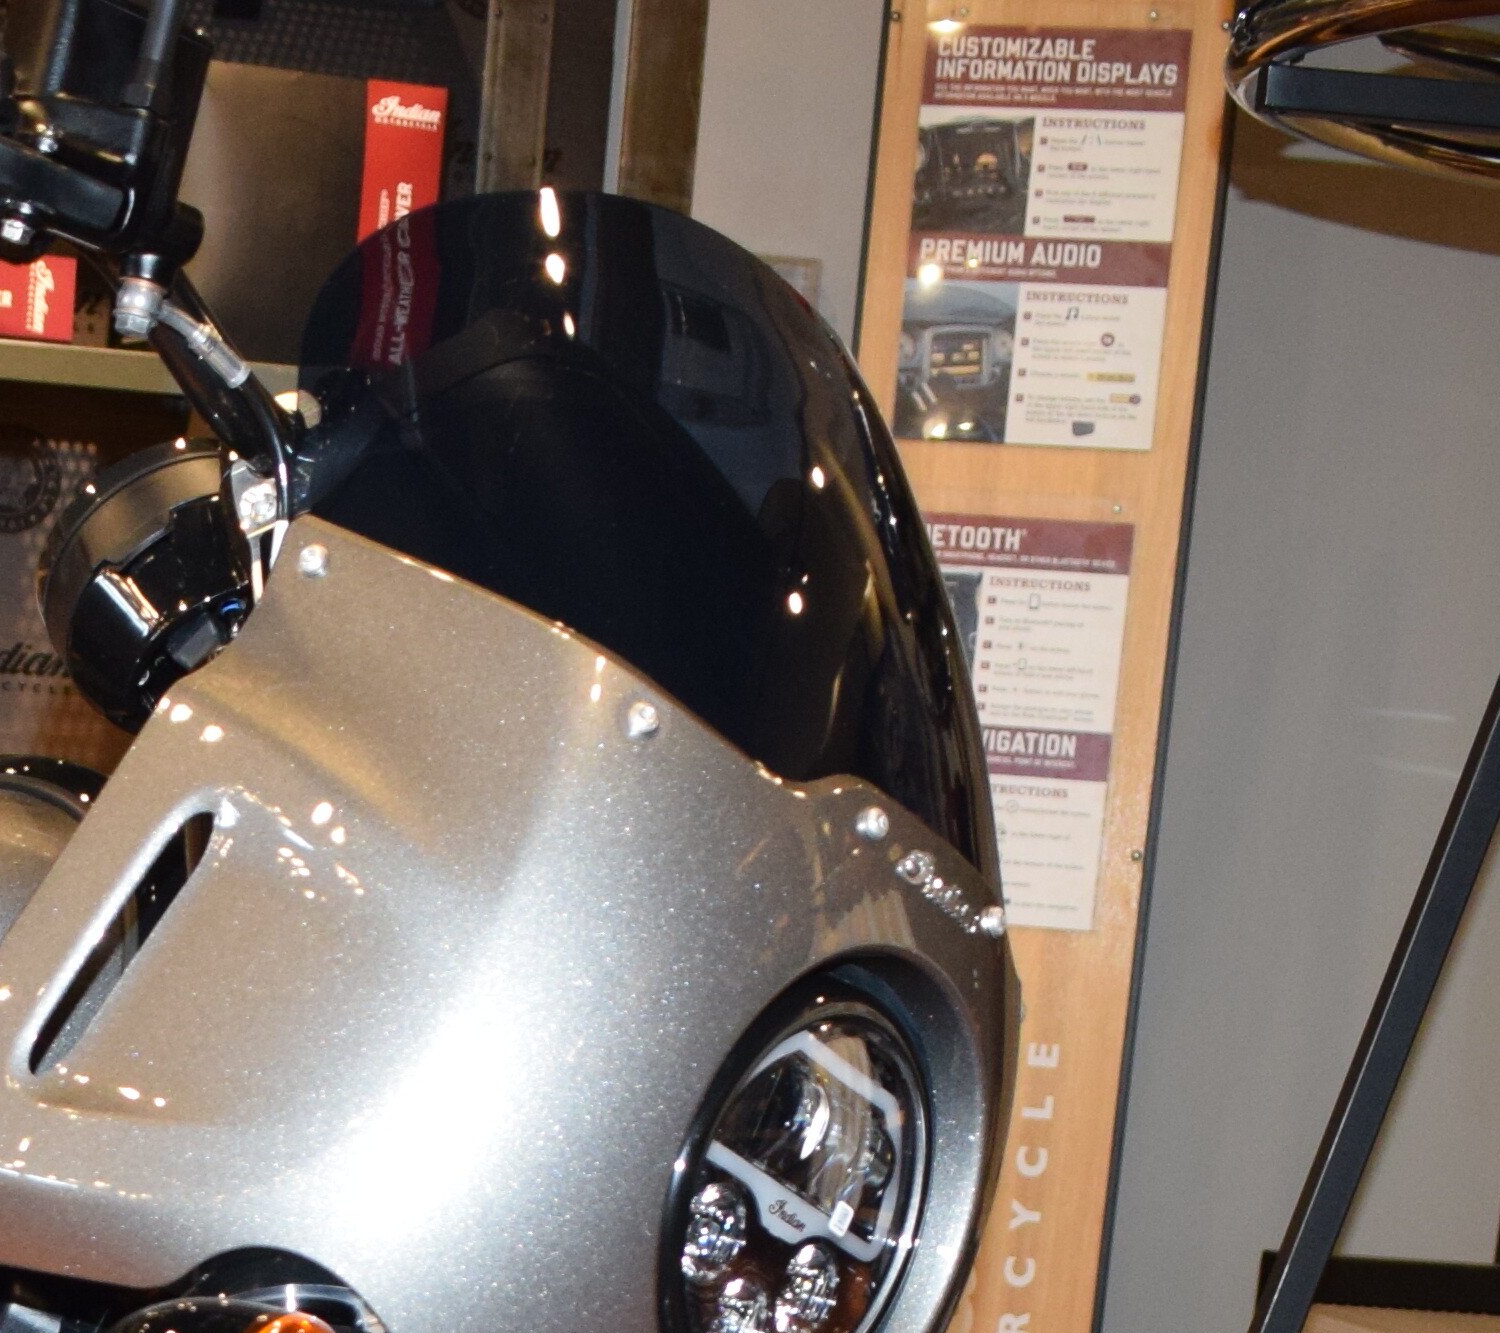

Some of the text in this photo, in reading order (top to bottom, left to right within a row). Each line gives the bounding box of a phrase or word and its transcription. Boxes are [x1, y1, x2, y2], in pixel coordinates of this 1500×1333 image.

[937, 35, 1097, 61] CUSTOMIZABLE
[935, 57, 1179, 87] INFORMATION DISPLAYS
[371, 95, 442, 124] Indian
[1042, 117, 1146, 131] INSTRUCTIONS
[919, 238, 1102, 269] PREMIUM AUDIO
[1026, 290, 1129, 304] INSTRUCTIONS
[925, 523, 1029, 551] ETOOTH
[989, 576, 1091, 592] INSTRUCTIONS
[982, 728, 1077, 759] VIGATION
[990, 785, 1068, 799] TRUCTIONS
[768, 1198, 806, 1233] Indian
